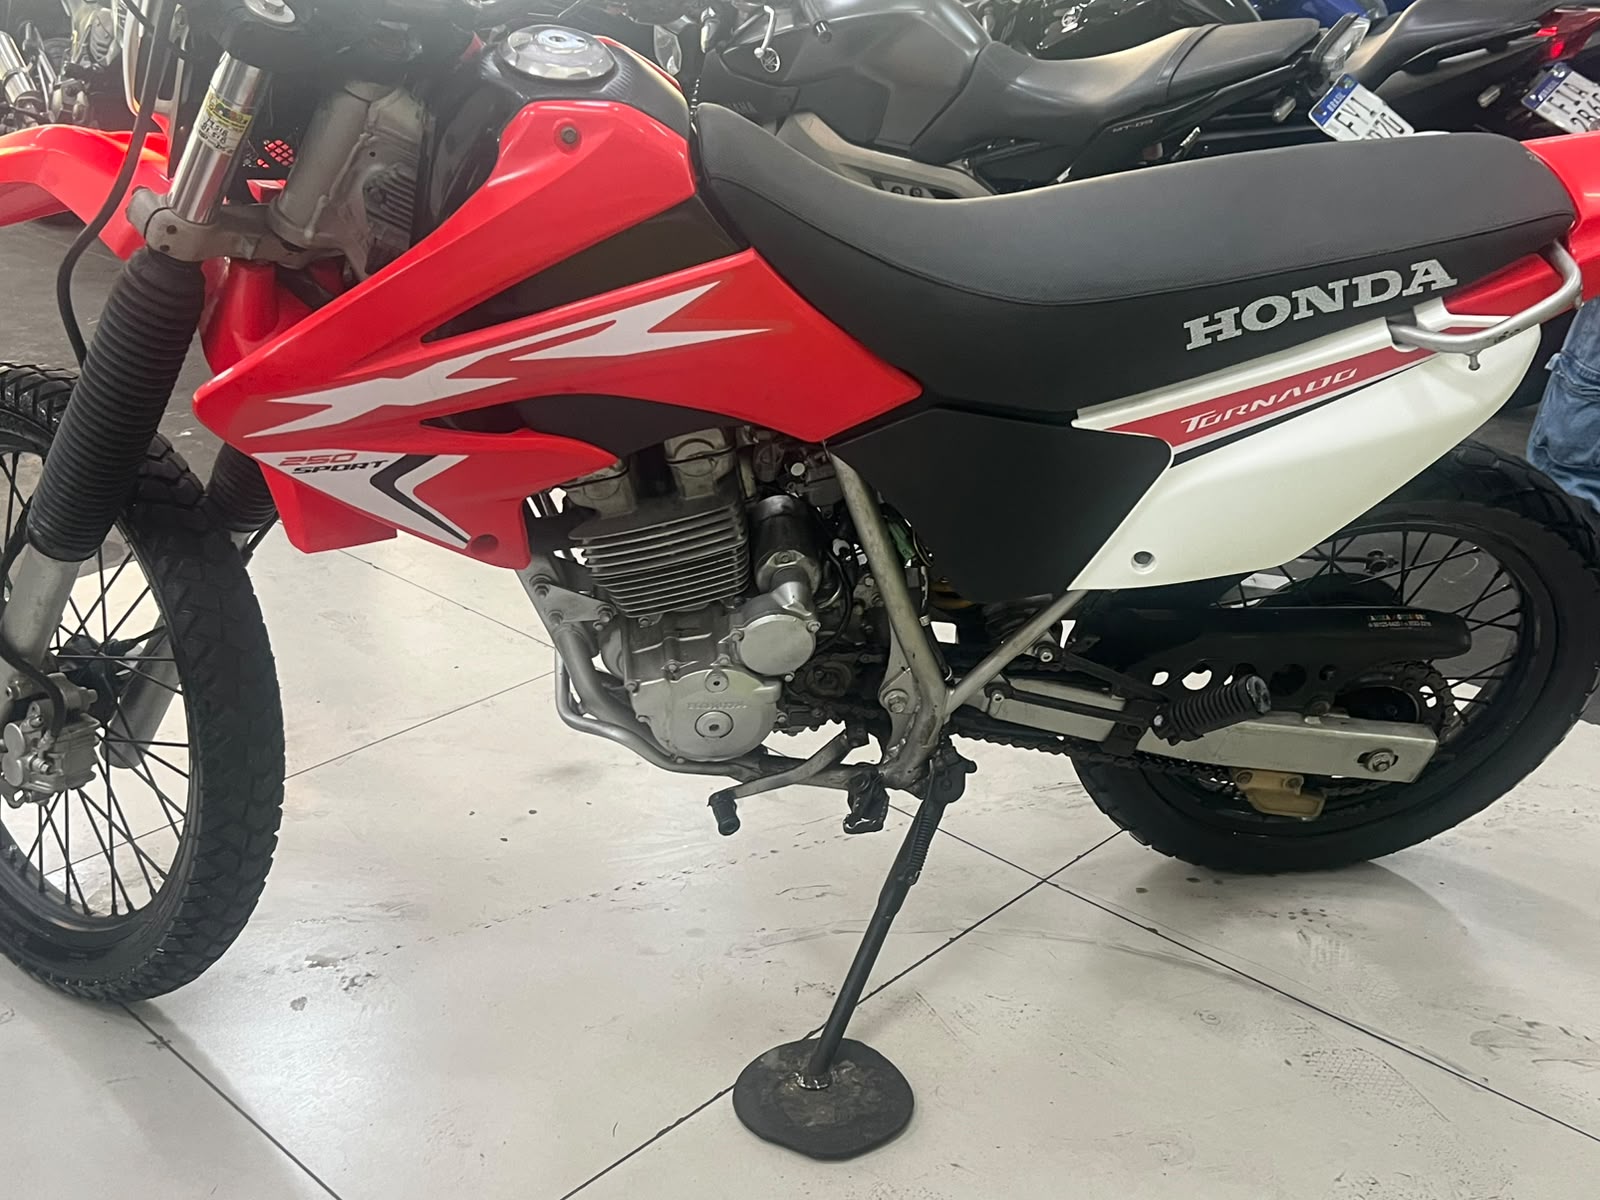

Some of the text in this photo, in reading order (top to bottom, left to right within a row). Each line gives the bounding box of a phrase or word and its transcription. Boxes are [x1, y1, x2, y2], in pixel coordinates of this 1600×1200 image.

[1183, 259, 1458, 351] HONDA
[1180, 368, 1358, 434] TORNADO
[278, 452, 358, 467] 250
[291, 459, 389, 475] SPORT
